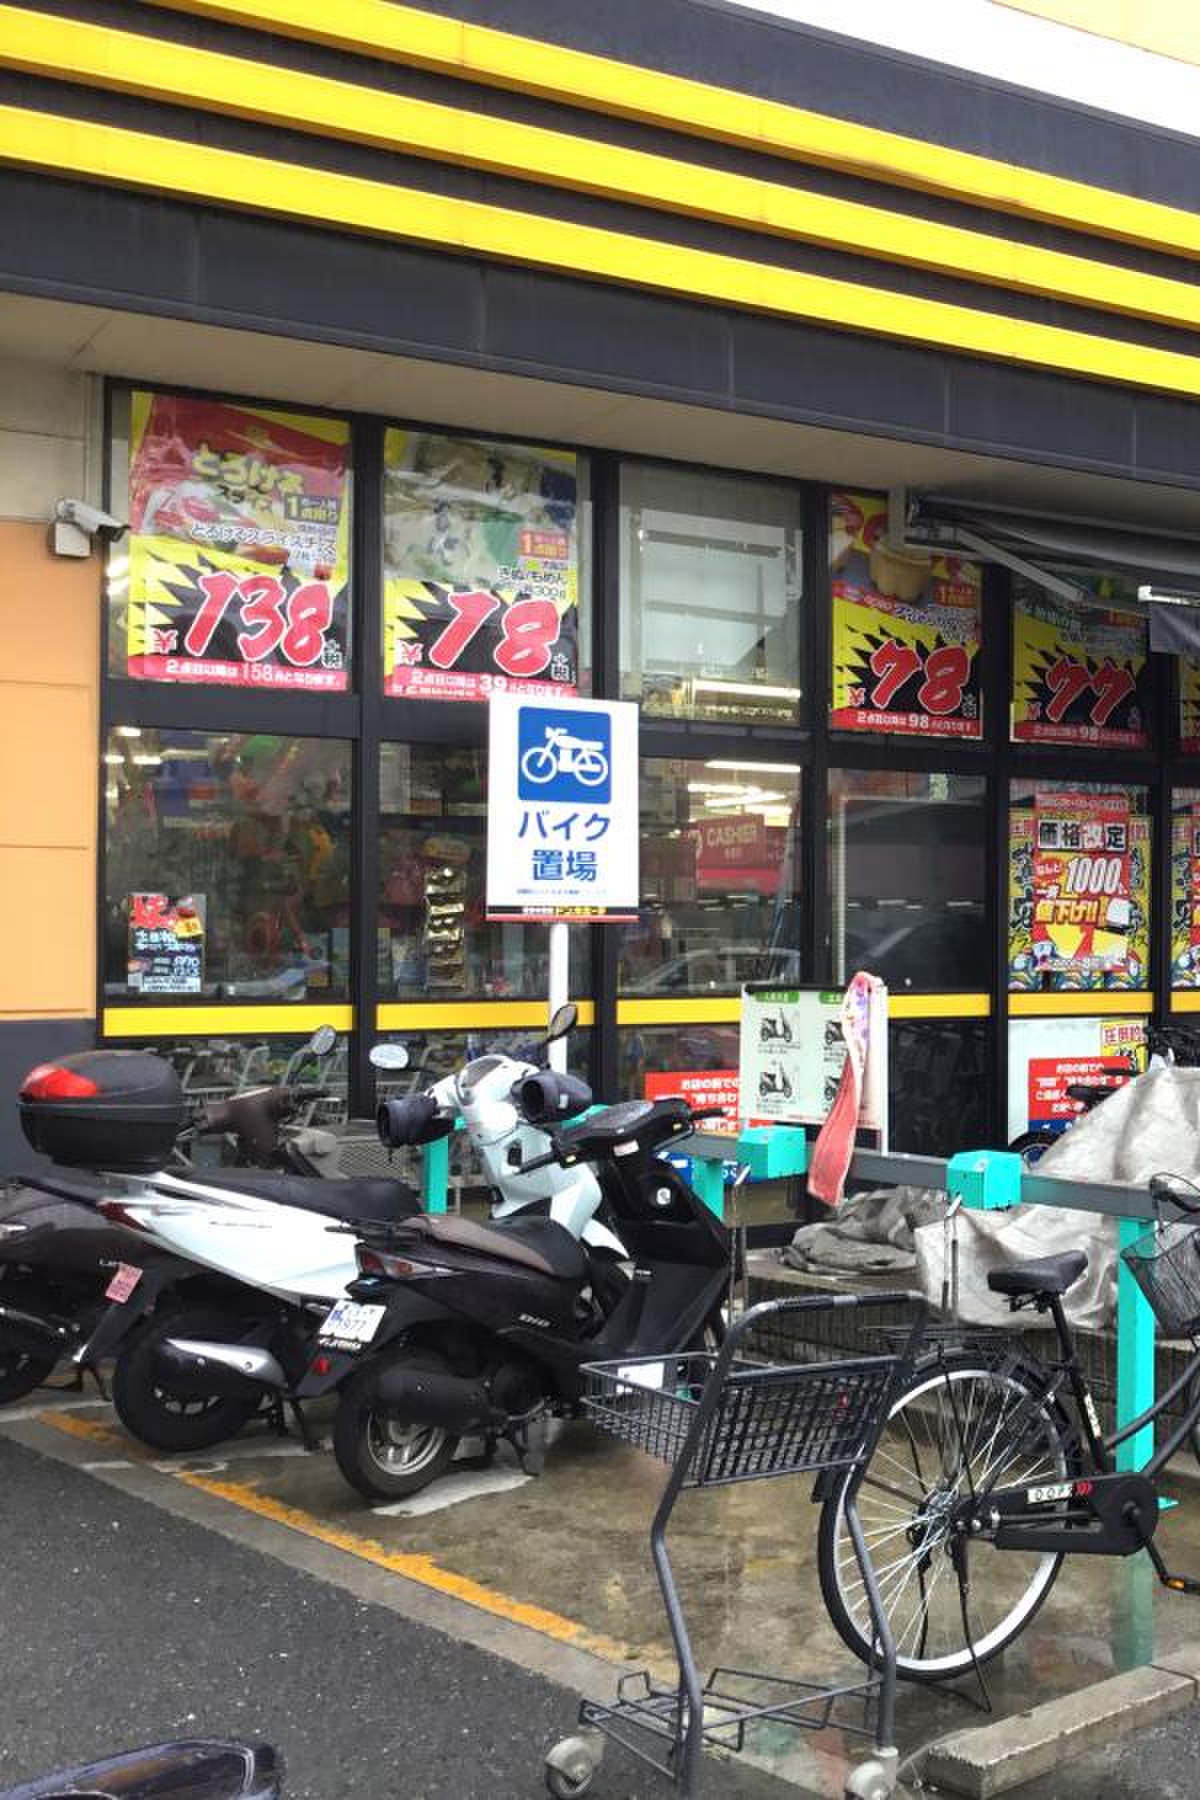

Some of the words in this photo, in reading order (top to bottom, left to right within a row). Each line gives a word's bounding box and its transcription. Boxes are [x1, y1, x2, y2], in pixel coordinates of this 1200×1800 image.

[184, 571, 334, 667] 138
[518, 811, 611, 841] バイク
[532, 849, 598, 882] 置場
